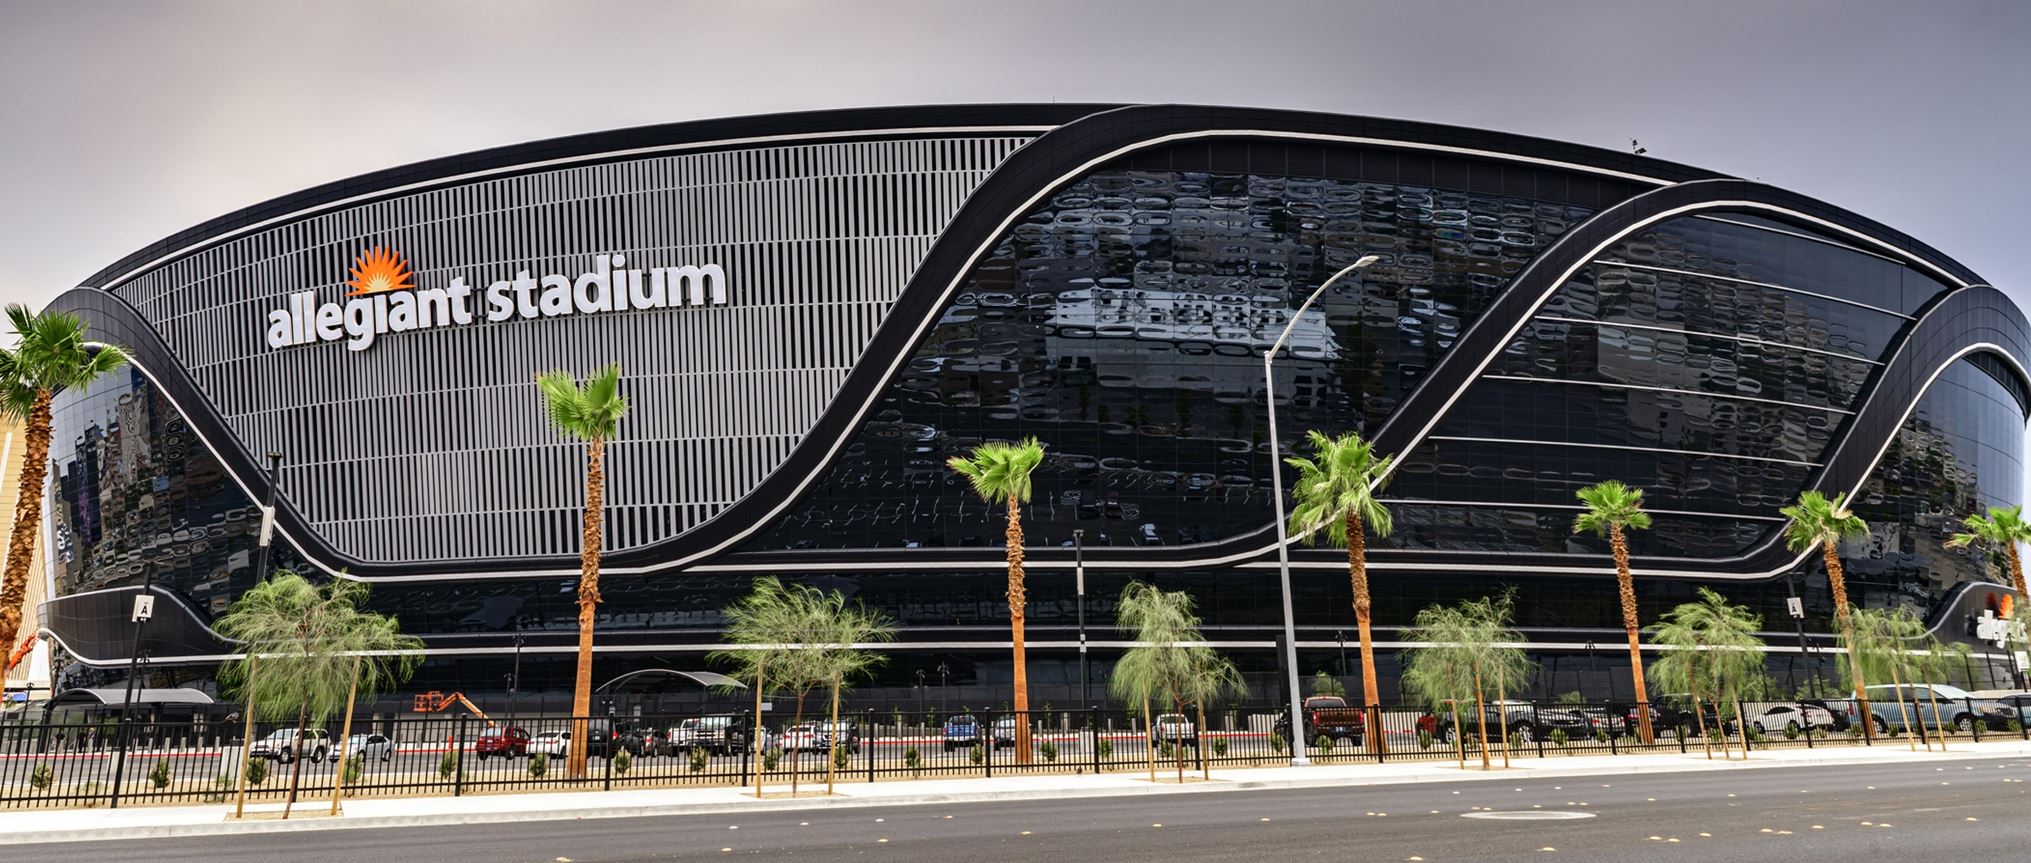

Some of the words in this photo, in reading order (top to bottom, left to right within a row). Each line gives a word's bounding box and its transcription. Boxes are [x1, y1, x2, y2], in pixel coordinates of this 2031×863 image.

[267, 276, 473, 351] allegiant
[487, 254, 727, 322] stadium
[141, 605, 148, 614] A
[1792, 605, 1797, 613] A
